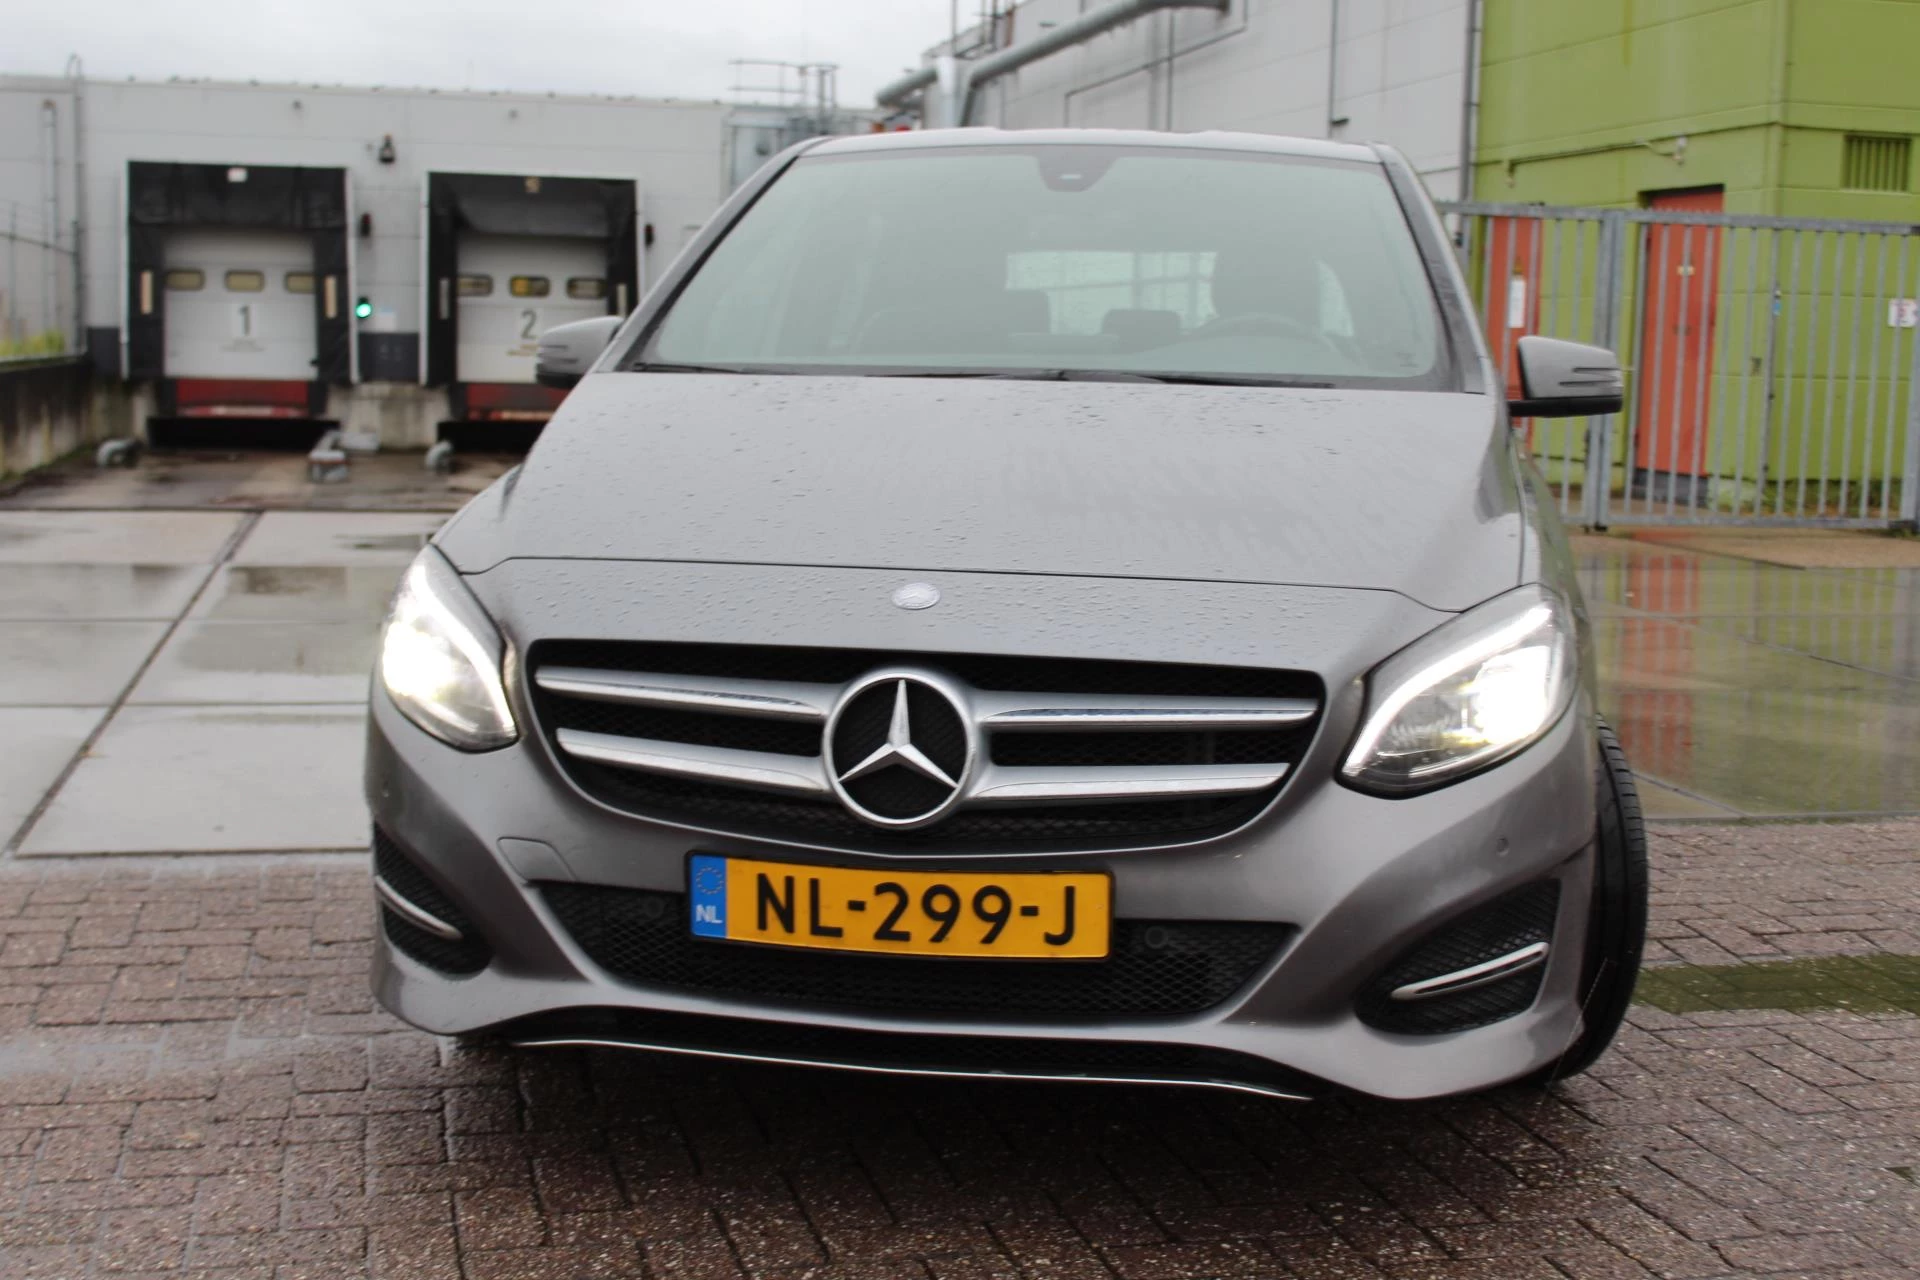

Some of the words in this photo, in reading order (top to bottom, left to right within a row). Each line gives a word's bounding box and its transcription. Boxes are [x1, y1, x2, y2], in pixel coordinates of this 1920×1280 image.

[238, 305, 251, 337] 1
[521, 308, 537, 340] 2
[696, 904, 723, 924] NL
[757, 873, 1076, 946] NL-299-J
